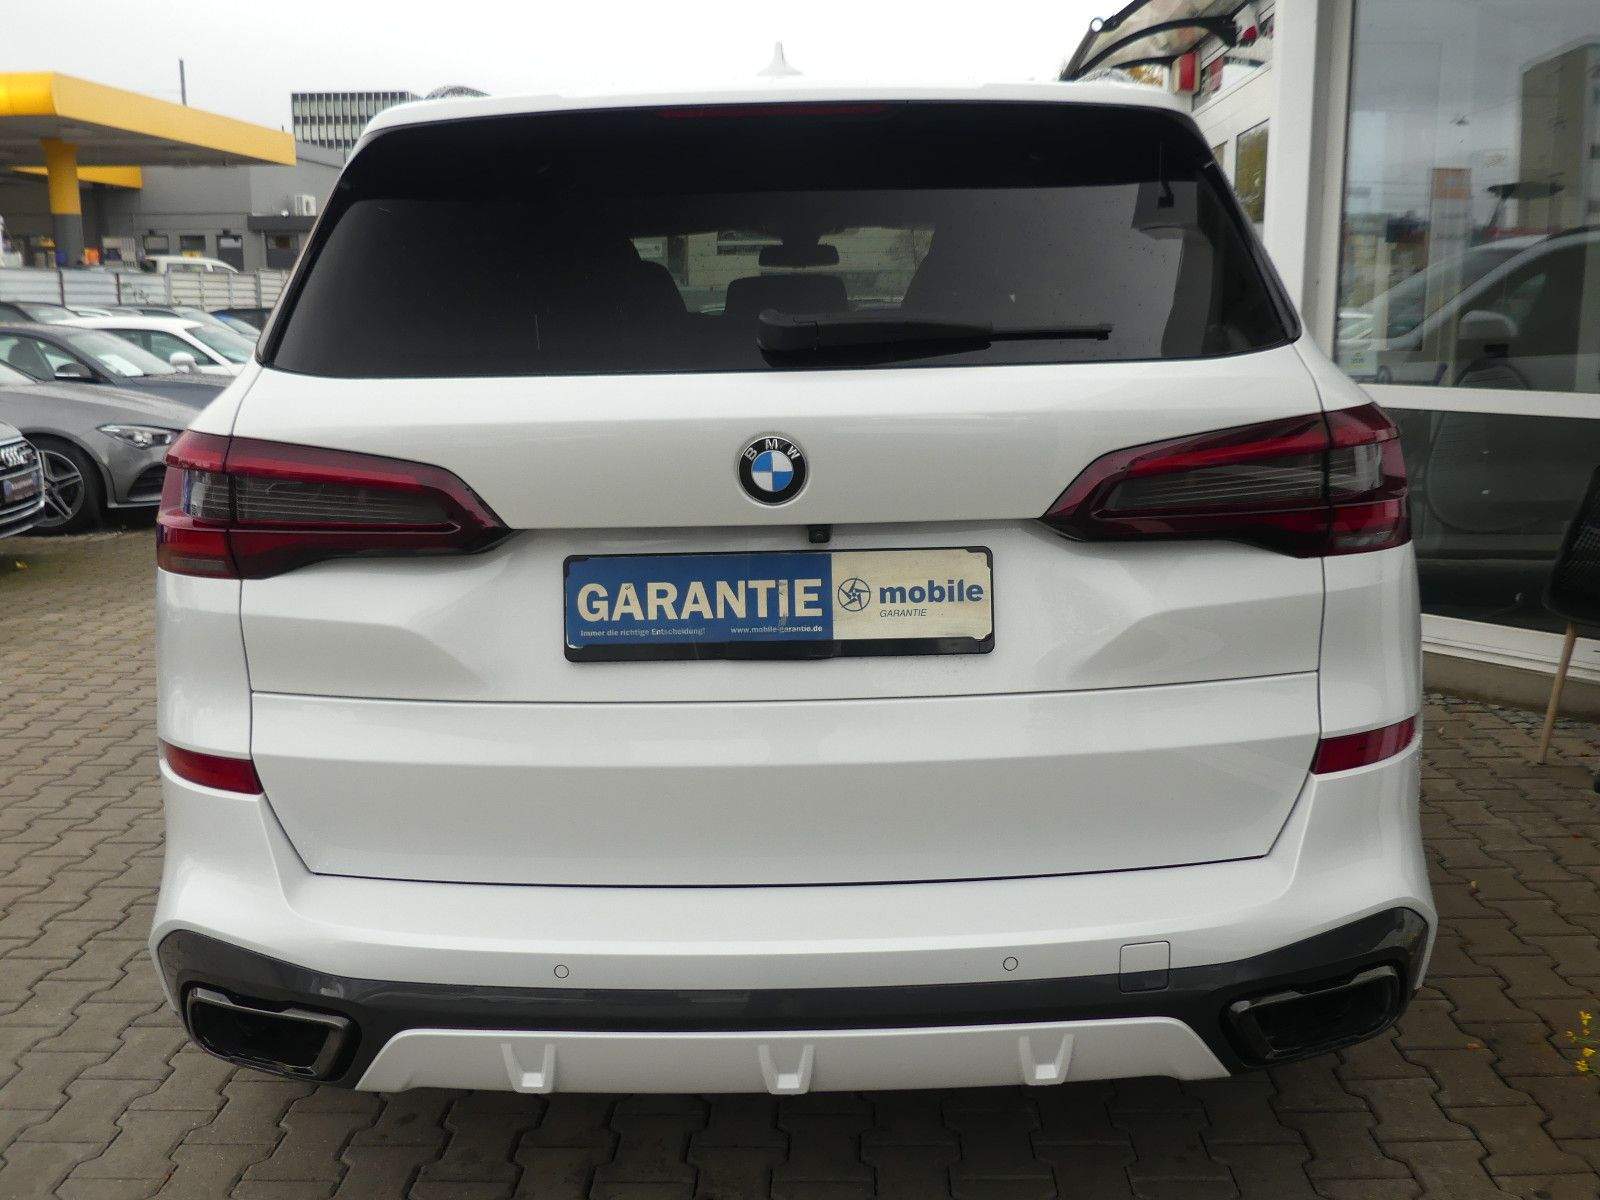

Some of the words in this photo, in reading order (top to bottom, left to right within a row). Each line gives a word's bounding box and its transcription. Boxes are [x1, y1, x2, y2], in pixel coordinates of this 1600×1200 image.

[743, 438, 801, 461] BMW
[879, 579, 984, 604] mobile
[577, 578, 824, 622] GARANTIE
[879, 608, 928, 618] GARANTIE
[580, 629, 604, 637] Immer
[606, 628, 619, 637] die
[620, 628, 650, 638] richtige
[730, 625, 823, 634] www.mobile-garantie.de
